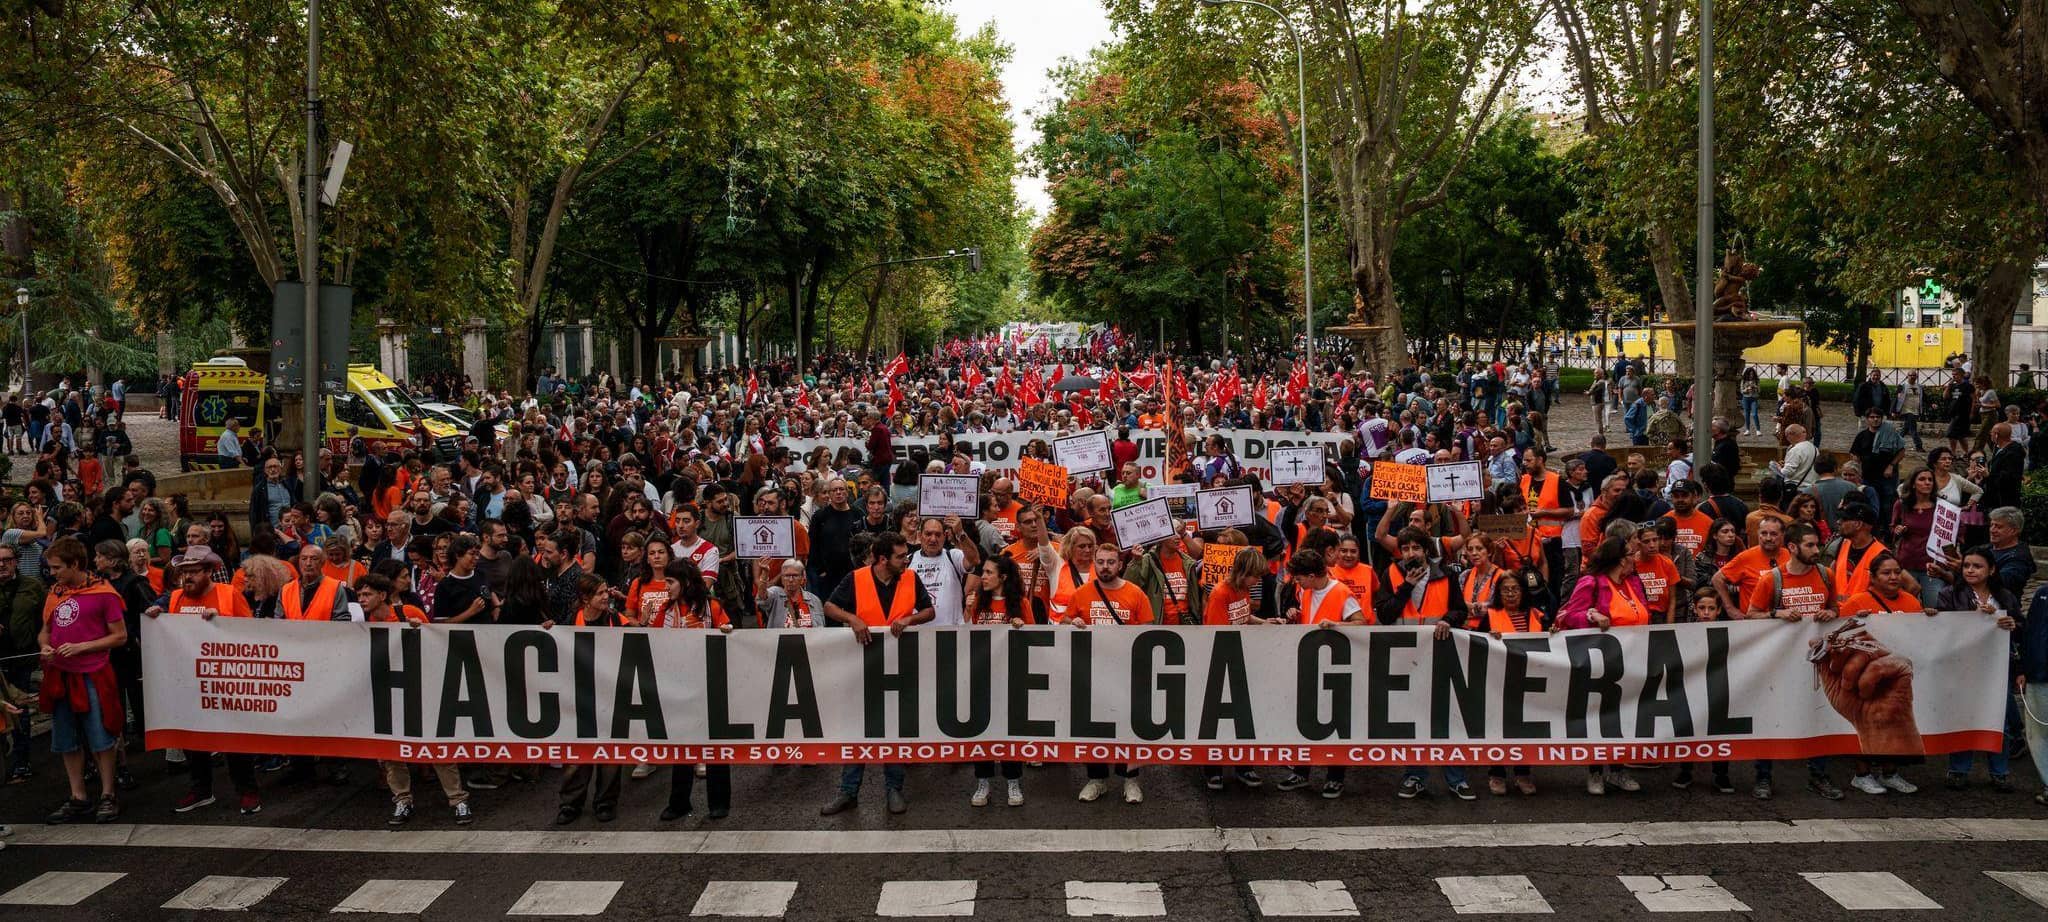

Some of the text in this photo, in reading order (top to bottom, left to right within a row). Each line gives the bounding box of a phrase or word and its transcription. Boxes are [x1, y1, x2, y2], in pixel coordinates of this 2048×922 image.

[1373, 479, 1420, 491] ESTAS CASAS
[1374, 489, 1425, 501] SON NUESTRAS
[200, 642, 278, 658] SINDICATO
[200, 661, 302, 678] DE INQUILINAS
[200, 680, 292, 697] E INQUILINOS
[370, 627, 1753, 740] HACIA LA HUELGA GENERAL
[201, 696, 278, 712] DE MADRID
[399, 744, 512, 759] BAJADA
[526, 745, 586, 759] DEL
[593, 746, 735, 761] ALQUILER
[749, 746, 803, 760] 50%
[841, 740, 1059, 759] EXPROPIACIÓN
[1074, 745, 1192, 760] FONDOS
[1208, 747, 1311, 760] BUITRE
[1348, 747, 1522, 761] CONTRATOS
[1538, 743, 1732, 760] INDEFINIDOS
